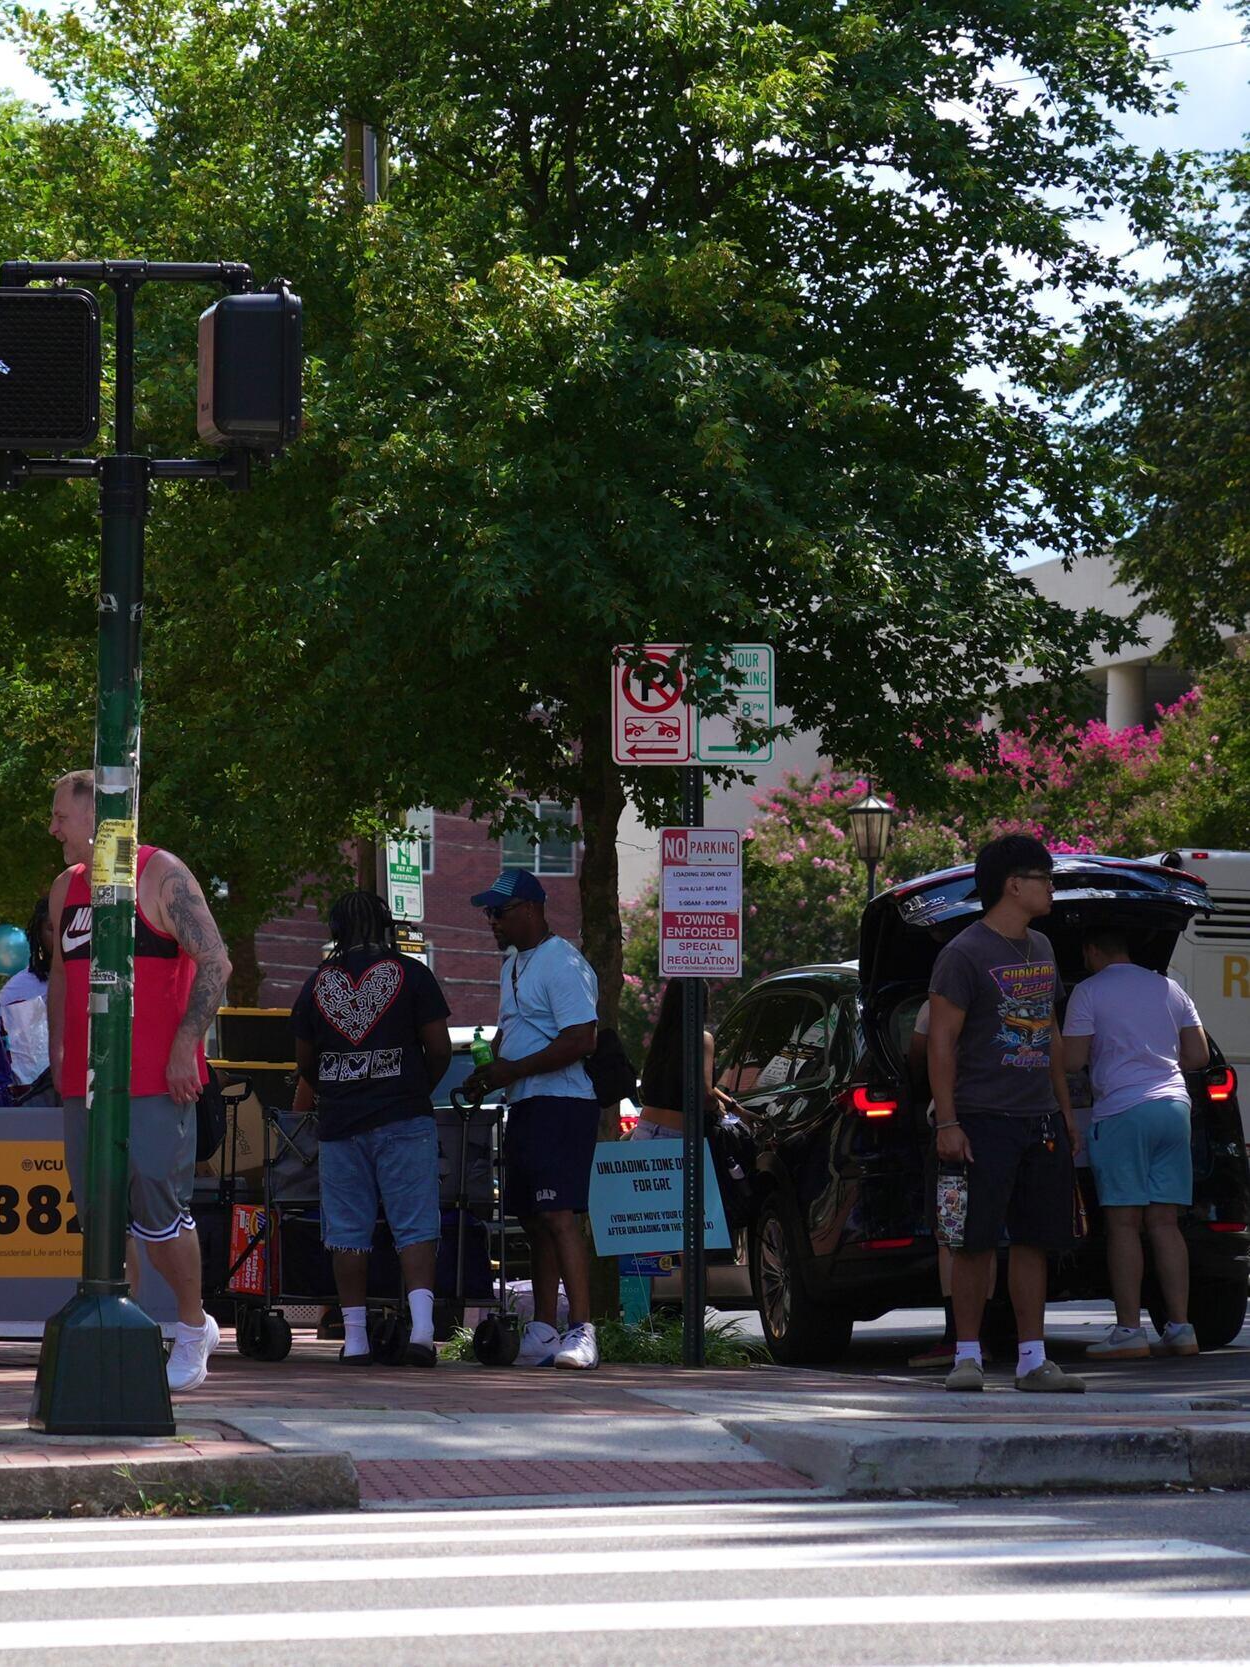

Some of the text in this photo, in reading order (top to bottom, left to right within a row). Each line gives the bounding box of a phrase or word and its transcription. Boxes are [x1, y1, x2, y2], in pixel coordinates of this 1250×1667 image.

[664, 837, 735, 859] NO PARKING
[676, 914, 725, 926] TOWING
[666, 927, 735, 938] ENFORCED
[678, 942, 724, 951] SPECIAL
[667, 956, 735, 965] REGULATION
[1223, 956, 1250, 998] R
[33, 1159, 64, 1171] VCU
[596, 1159, 650, 1175] UNLOADING
[651, 1158, 674, 1172] ZONE
[632, 1177, 672, 1192] FOR GRC
[536, 1189, 557, 1202] GAP
[610, 1213, 627, 1224] (YOU
[627, 1212, 643, 1223] MUST
[643, 1211, 661, 1221] MOVE
[661, 1210, 678, 1220] YOUR
[608, 1225, 627, 1236] AFTER
[627, 1223, 661, 1235] UNLOADING
[661, 1223, 670, 1232] ON
[670, 1222, 682, 1231] THE
[33, 1248, 47, 1257] Life
[48, 1248, 62, 1257] and
[63, 1248, 83, 1257] Hous
